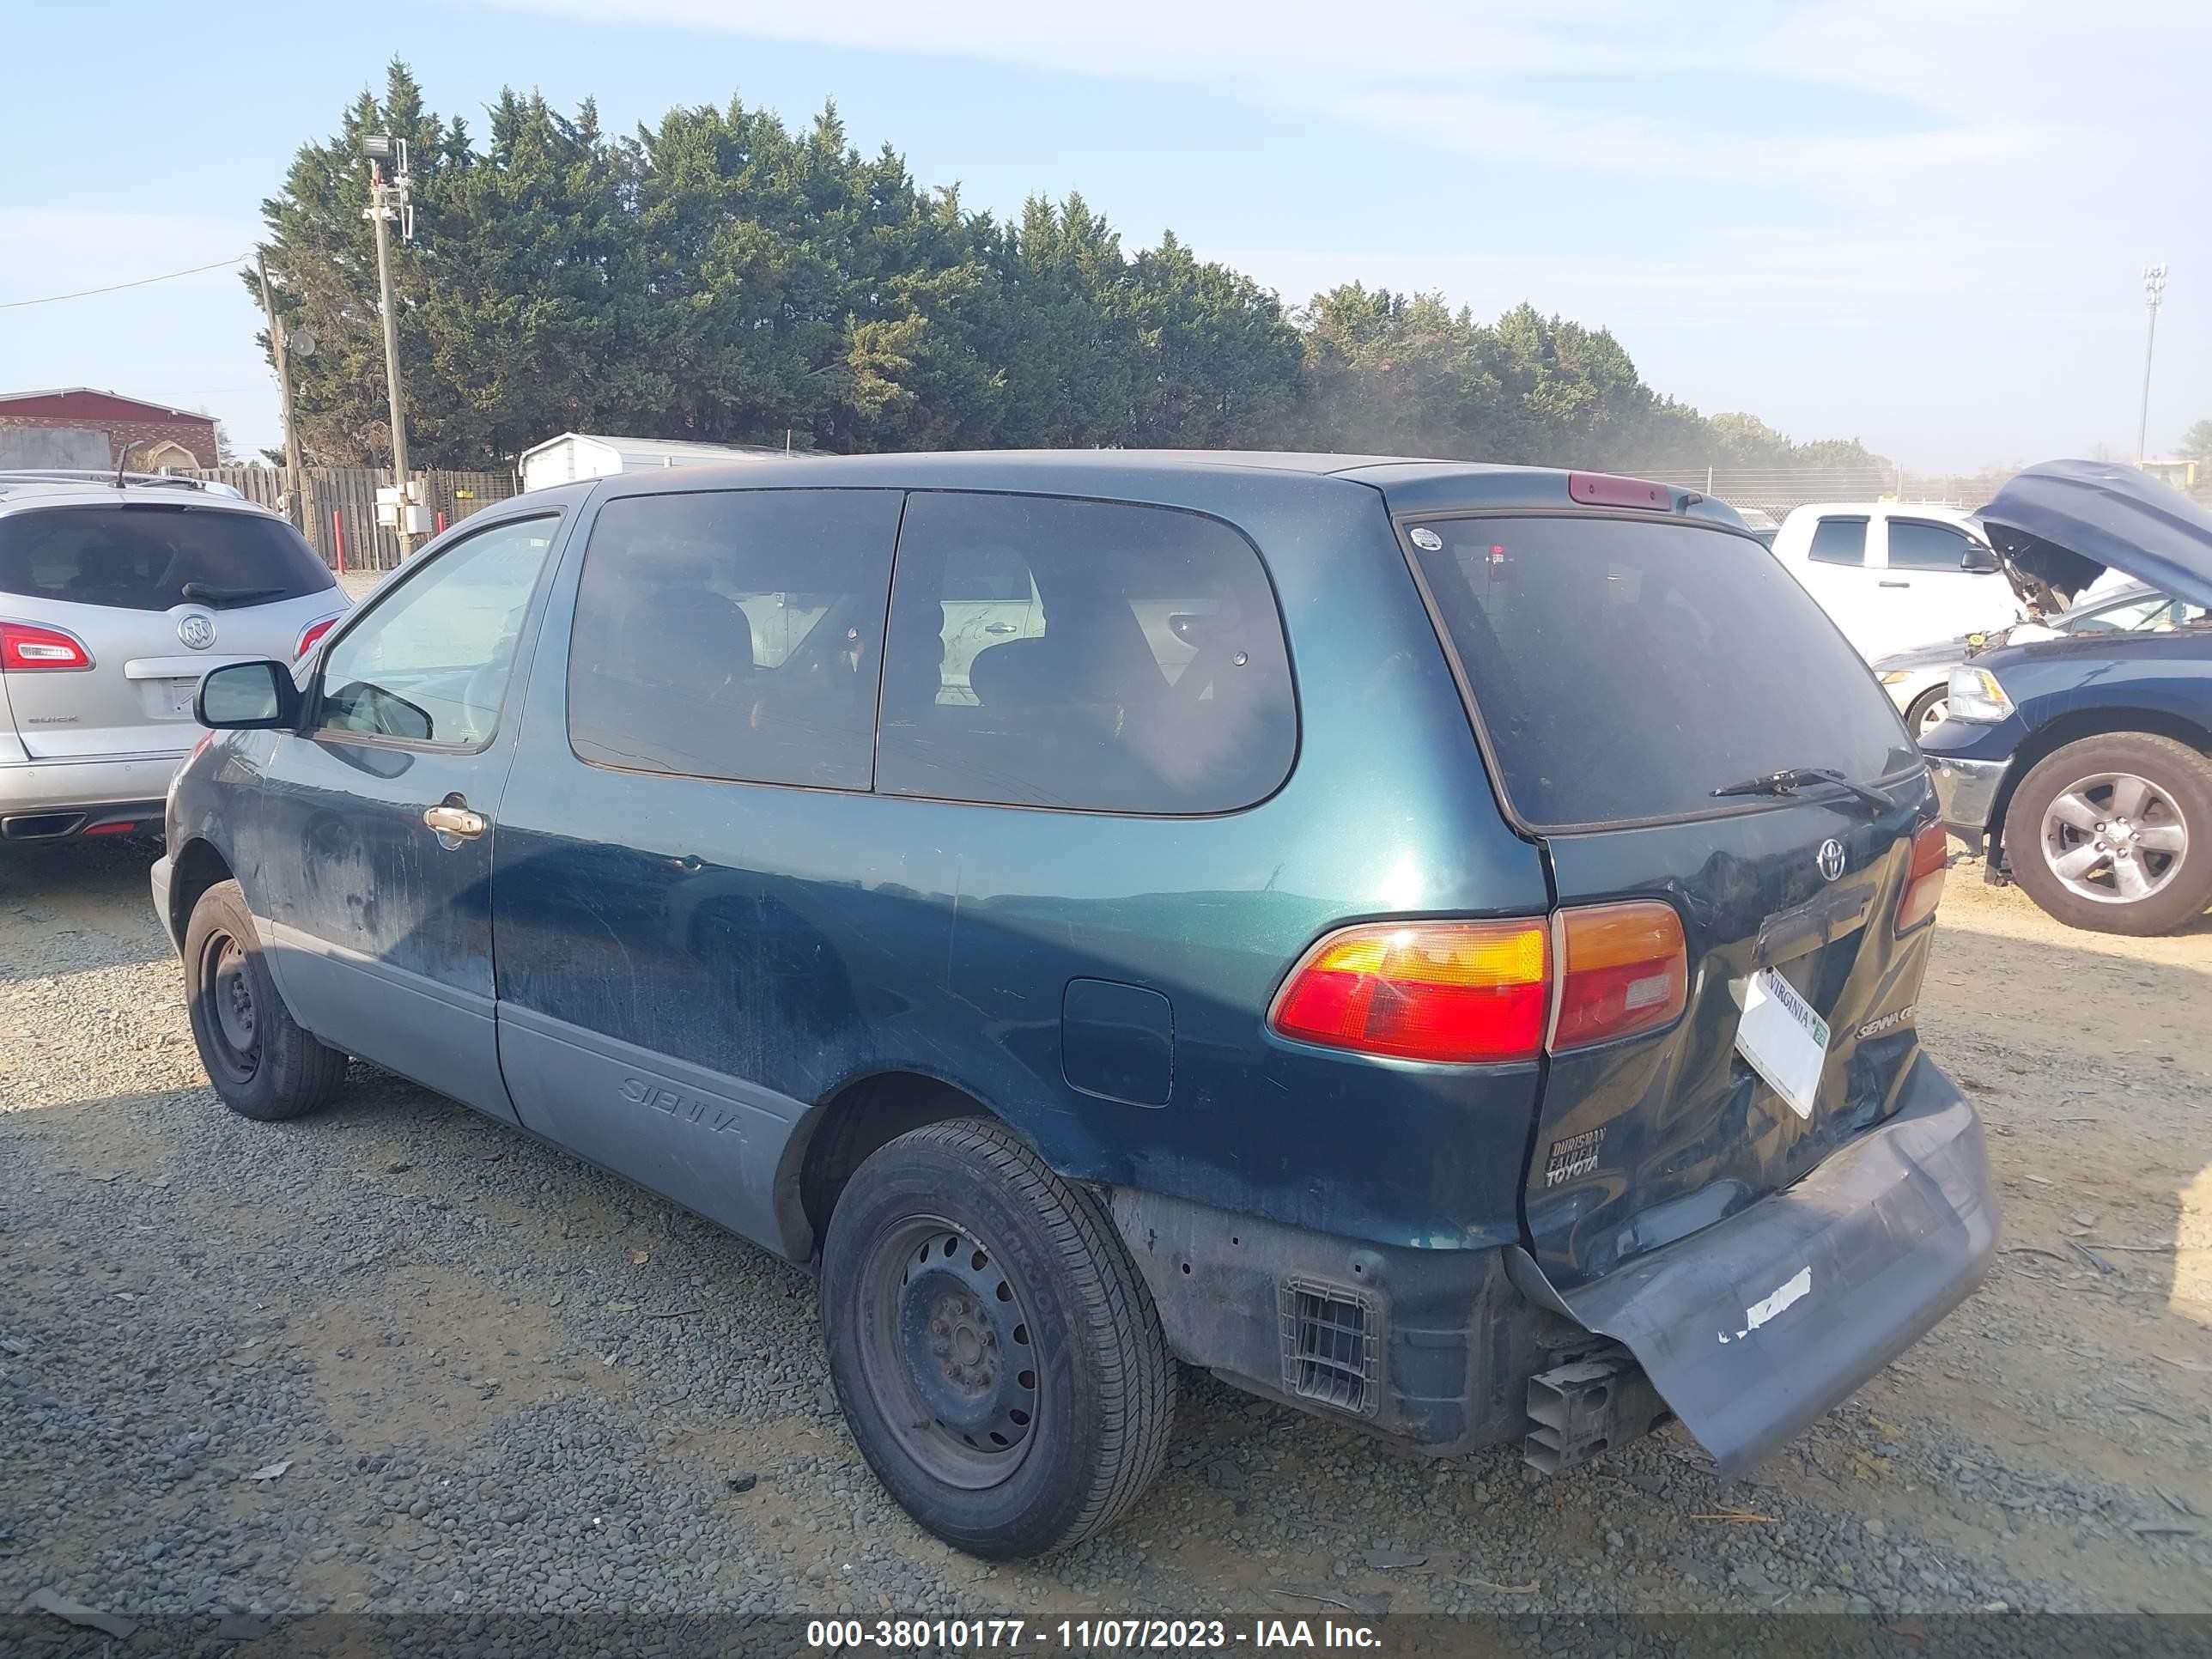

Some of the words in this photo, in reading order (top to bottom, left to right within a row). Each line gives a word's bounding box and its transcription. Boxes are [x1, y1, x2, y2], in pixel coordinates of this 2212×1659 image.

[27, 715, 79, 724] BUICK
[1770, 973, 1809, 1029] VIRGINIA
[1856, 1012, 1899, 1039] SIENNA
[617, 1077, 749, 1144] SIENNA
[1546, 1155, 1598, 1188] TOYOTA
